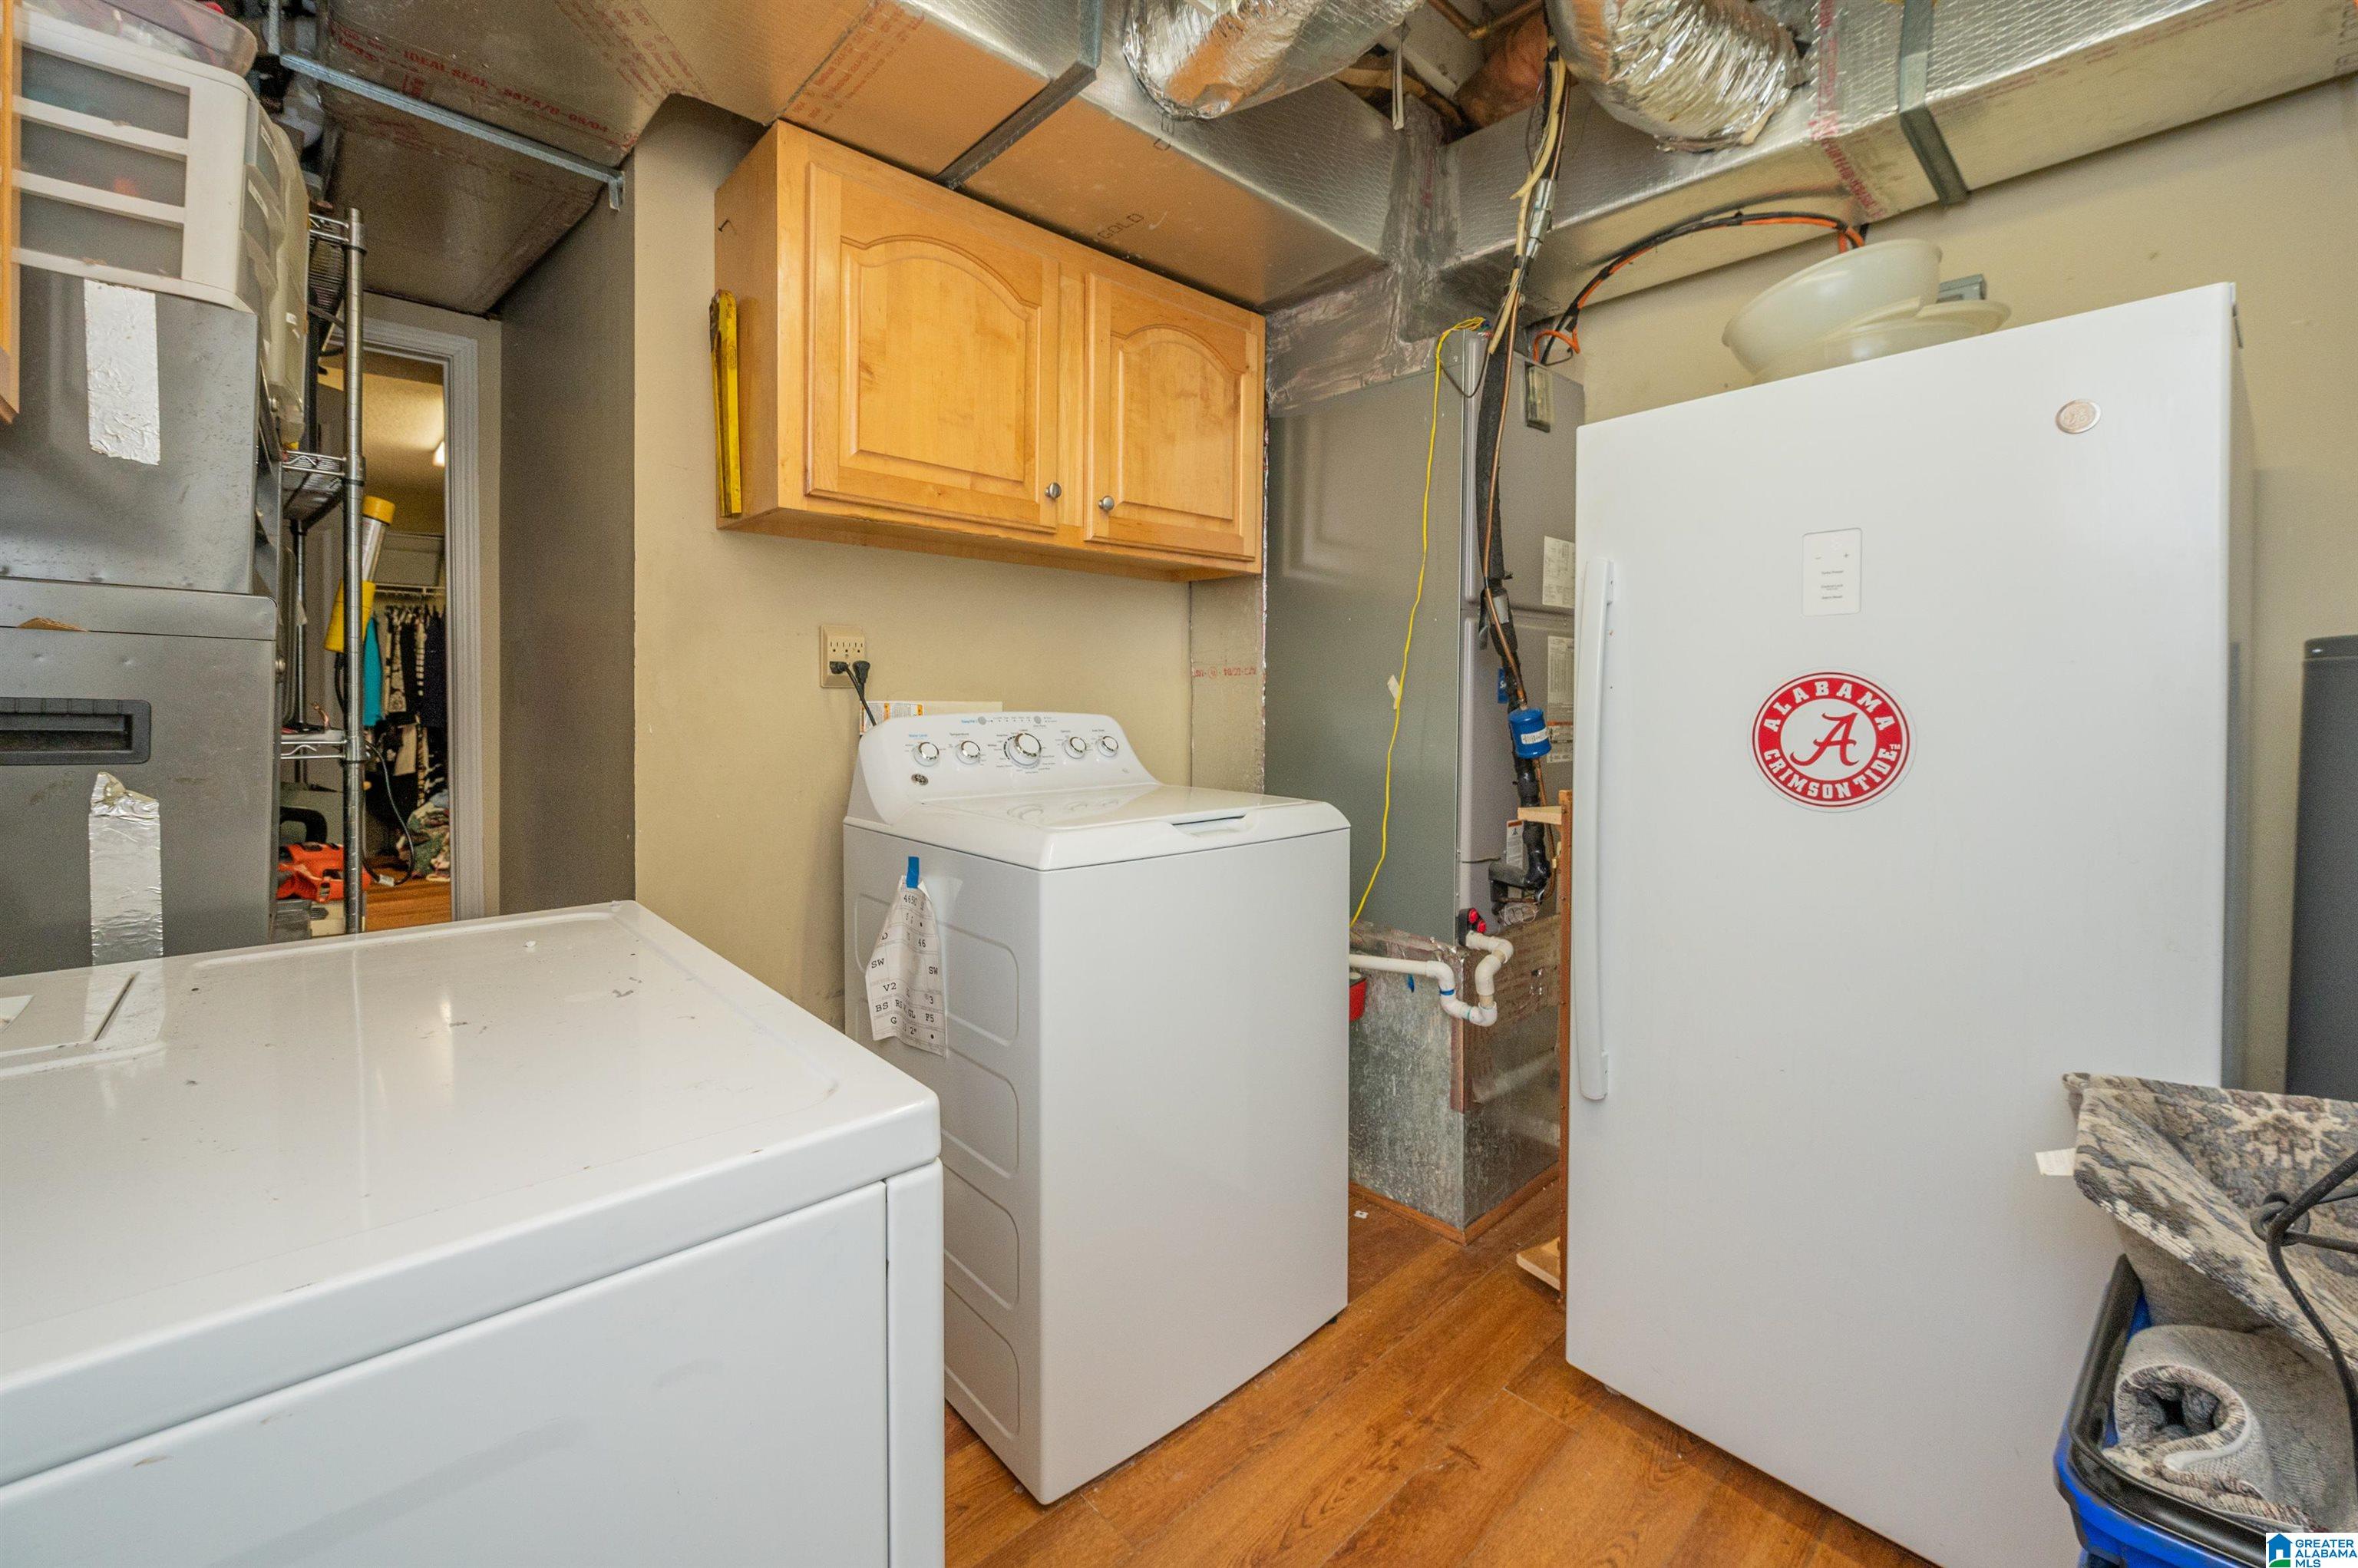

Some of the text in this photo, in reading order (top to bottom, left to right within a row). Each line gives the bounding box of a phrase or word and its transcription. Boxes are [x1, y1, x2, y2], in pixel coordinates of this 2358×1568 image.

[1763, 680, 1895, 733] ALABAMA
[1789, 711, 1860, 767] A
[1763, 748, 1852, 799] CRIMSON
[1854, 748, 1898, 791] TIDE
[918, 938, 926, 949] 46
[870, 958, 939, 976] SW SW
[883, 982, 897, 992] V2
[875, 1002, 889, 1012] BS
[890, 1016, 897, 1025] G
